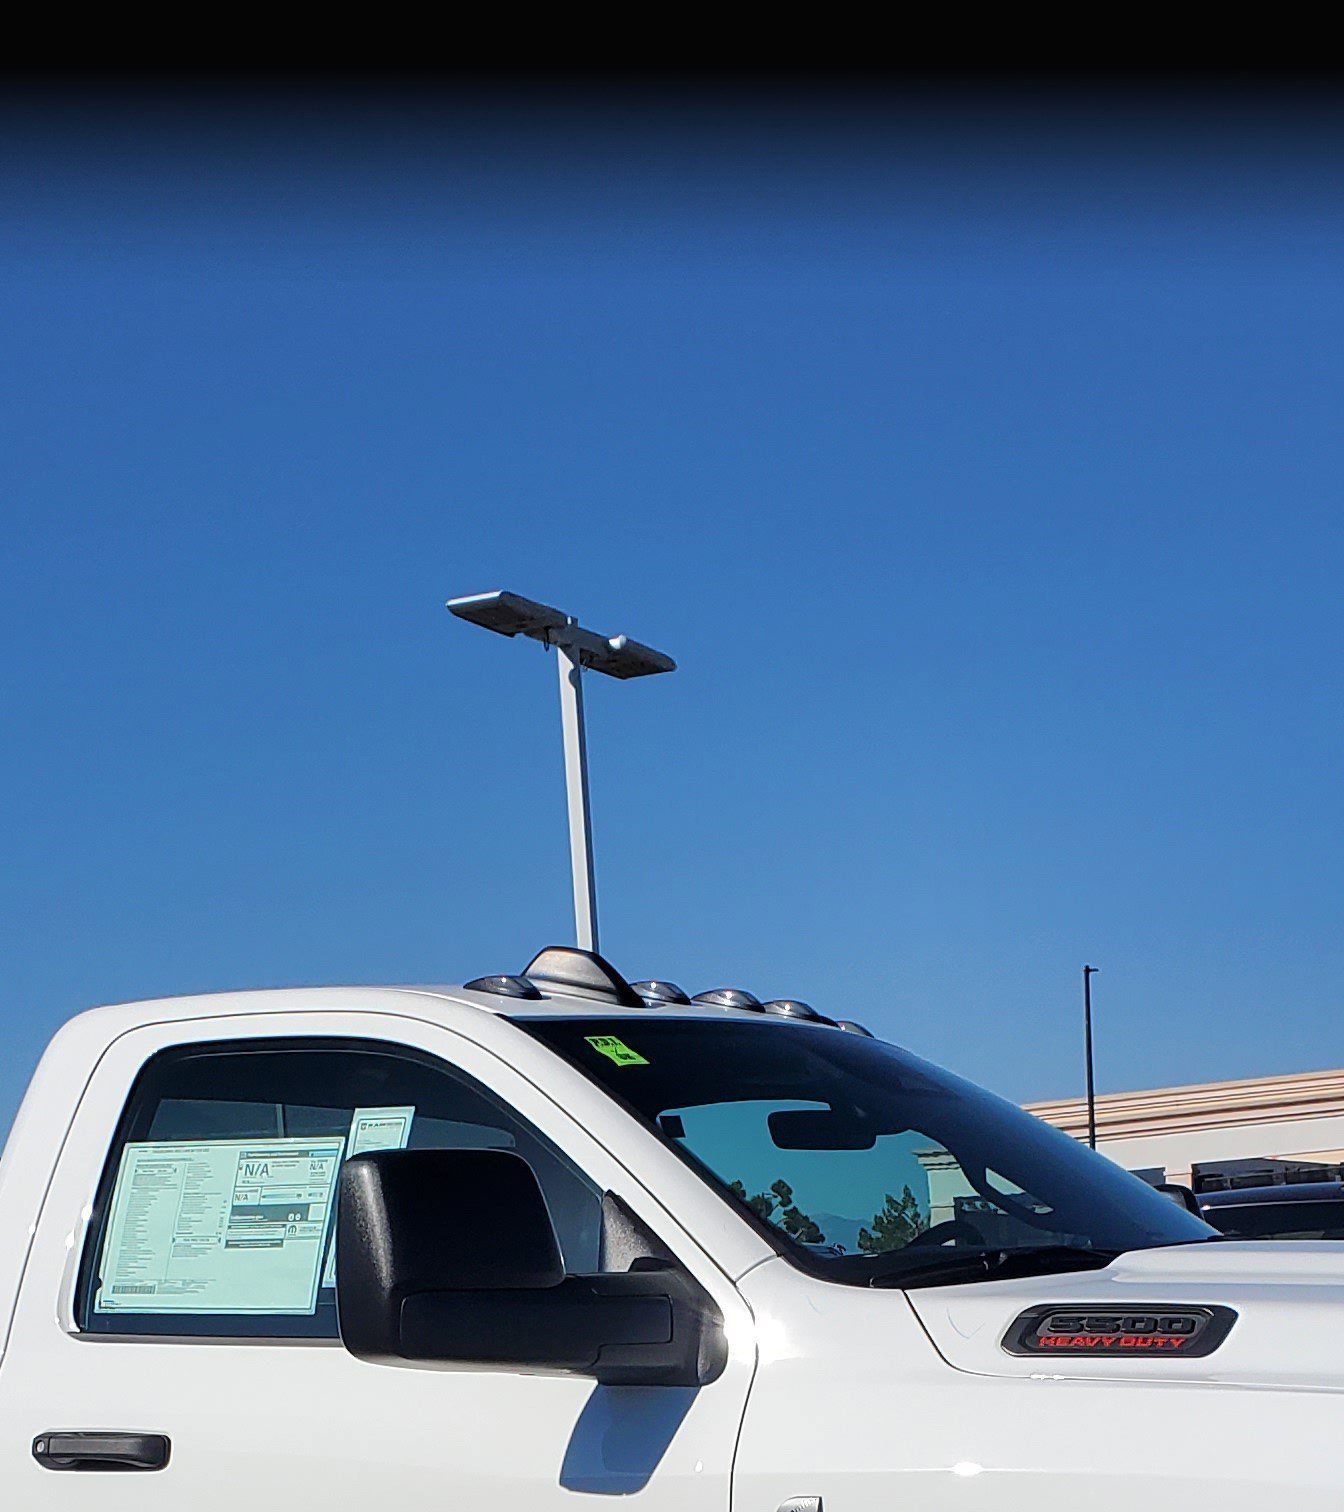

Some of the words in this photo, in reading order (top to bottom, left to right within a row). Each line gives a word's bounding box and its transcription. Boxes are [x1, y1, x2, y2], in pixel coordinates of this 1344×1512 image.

[244, 1163, 271, 1177] N/A
[1047, 1316, 1197, 1334] 5500
[1038, 1336, 1116, 1347] HEAVY
[1119, 1336, 1186, 1348] DUTY
